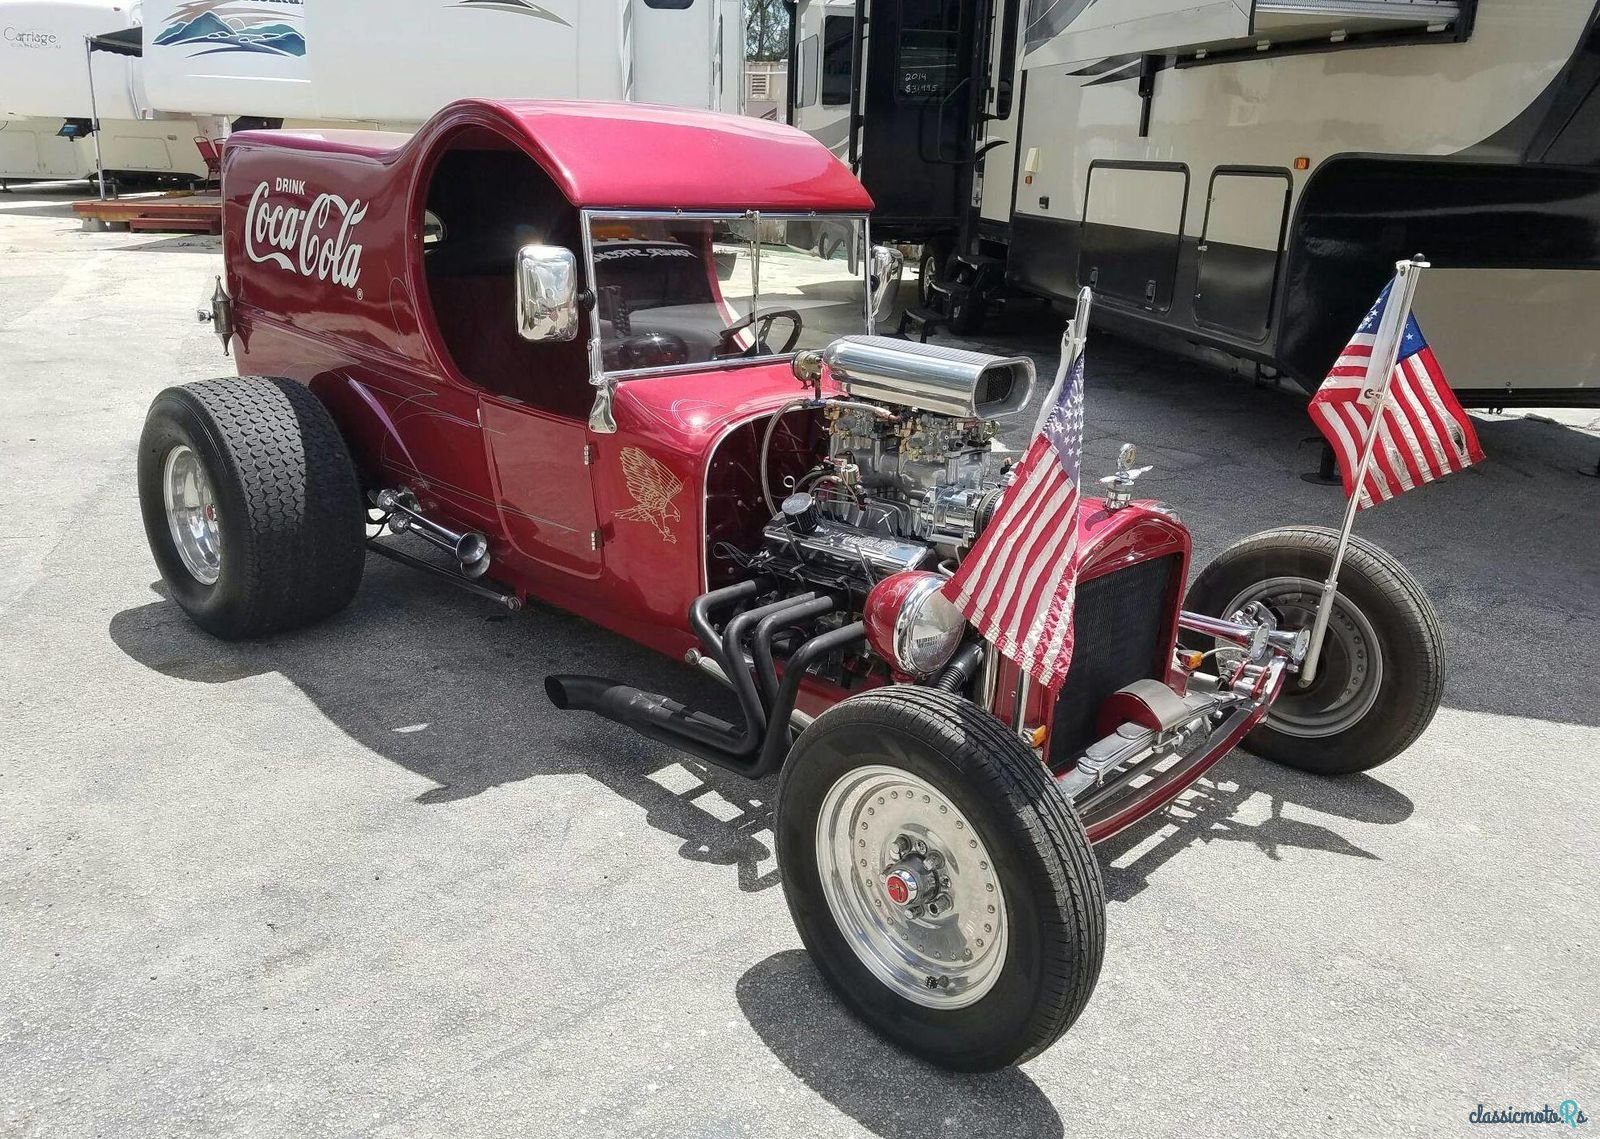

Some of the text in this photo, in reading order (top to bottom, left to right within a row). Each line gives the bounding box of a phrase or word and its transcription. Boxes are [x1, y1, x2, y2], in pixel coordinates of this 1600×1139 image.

[3, 26, 57, 46] Carriage
[904, 72, 927, 82] 2014
[275, 176, 306, 196] DRINK
[245, 181, 369, 289] Coca-Cola
